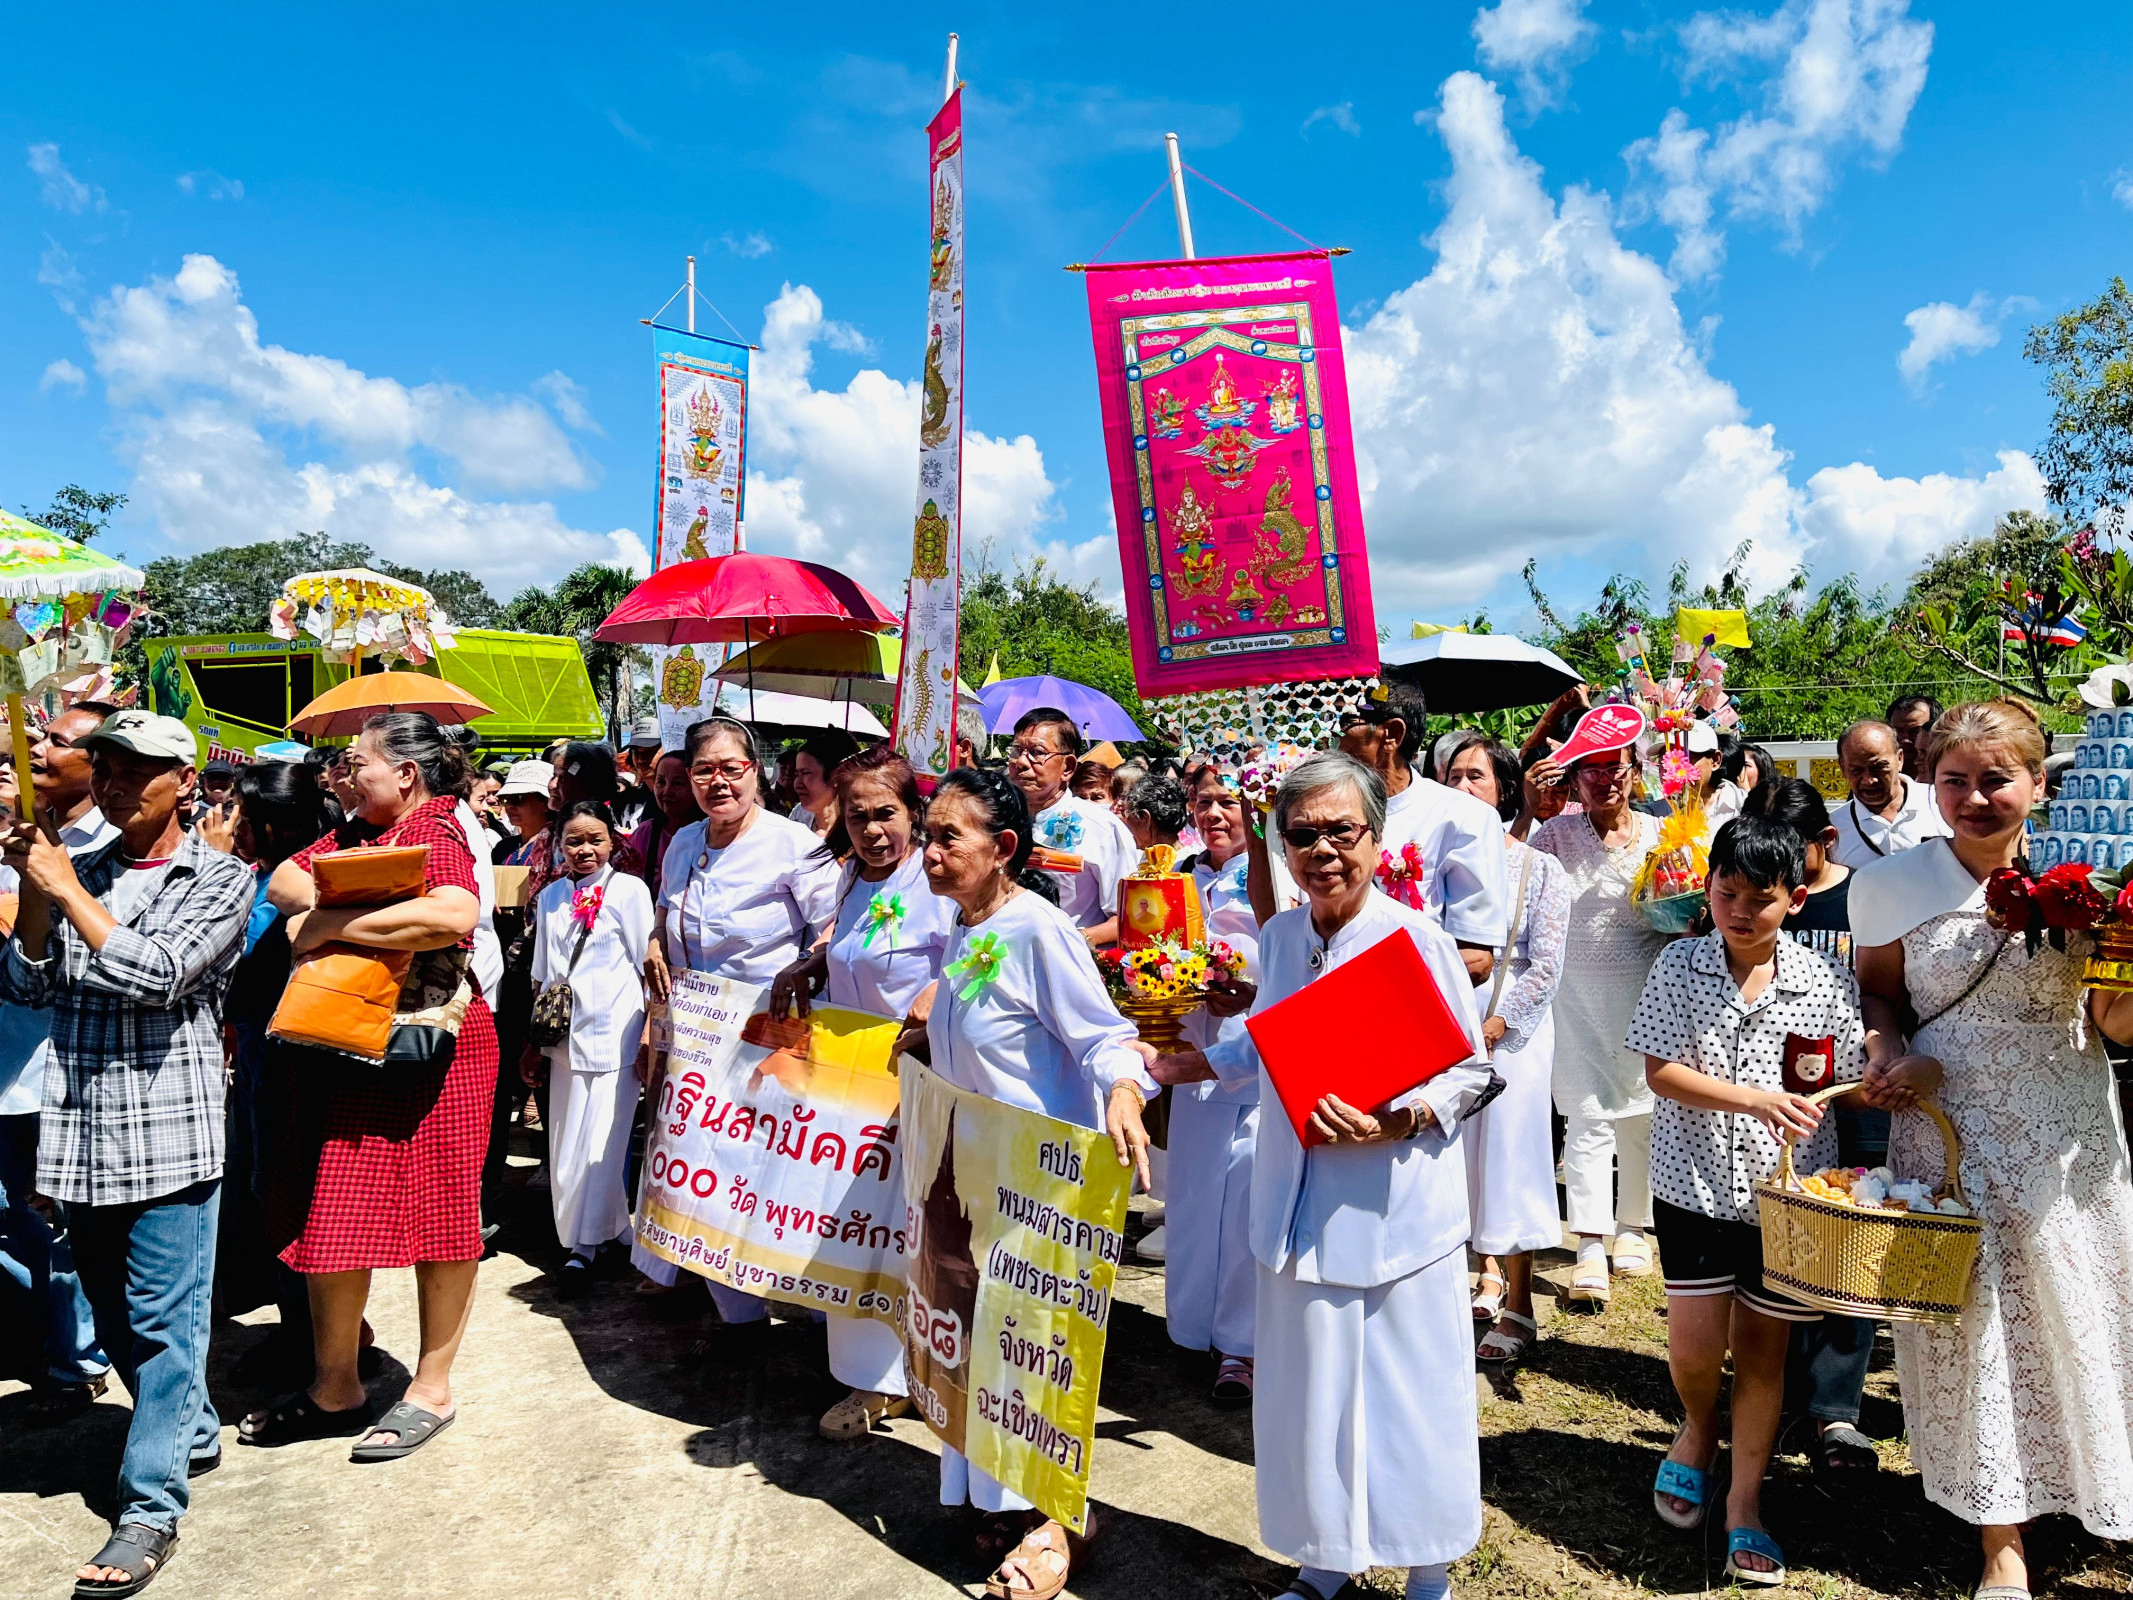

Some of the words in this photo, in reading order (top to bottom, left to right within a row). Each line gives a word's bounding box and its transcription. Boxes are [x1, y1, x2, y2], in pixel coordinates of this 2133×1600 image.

[729, 1175, 758, 1216] วัด
[1039, 1141, 1086, 1187] ศปธ.
[997, 1185, 1122, 1264] พนมสารคาม
[735, 1260, 848, 1305] บูชาธรรม
[858, 1292, 891, 1313] ๘๑
[989, 1238, 1108, 1330] (เพชรตะวัน)
[998, 1315, 1073, 1393] จังหวัด
[976, 1387, 1083, 1474] ฉะเชิงเทรา
[1664, 1470, 1696, 1491] FILA
